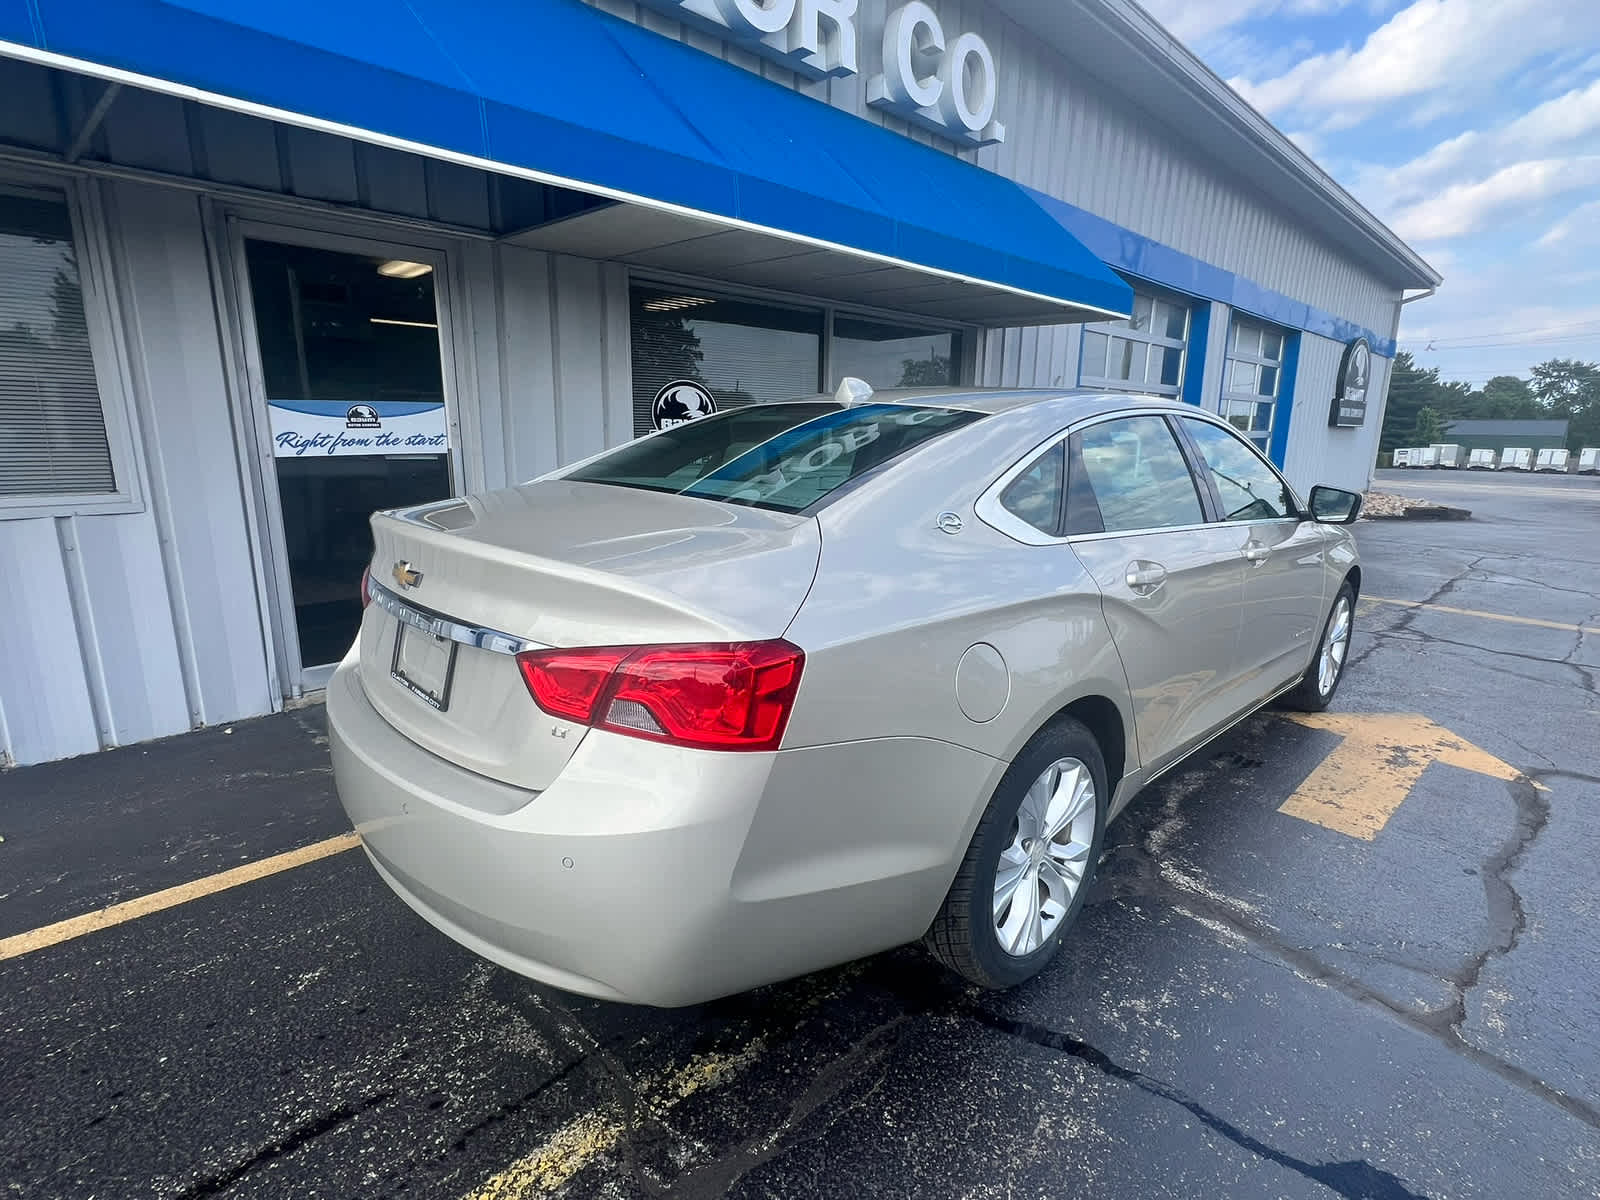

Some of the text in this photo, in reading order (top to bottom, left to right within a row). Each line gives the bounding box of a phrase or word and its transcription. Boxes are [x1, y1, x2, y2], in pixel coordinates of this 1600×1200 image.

[275, 431, 330, 455] Right
[328, 432, 375, 454] from
[375, 432, 402, 446] the
